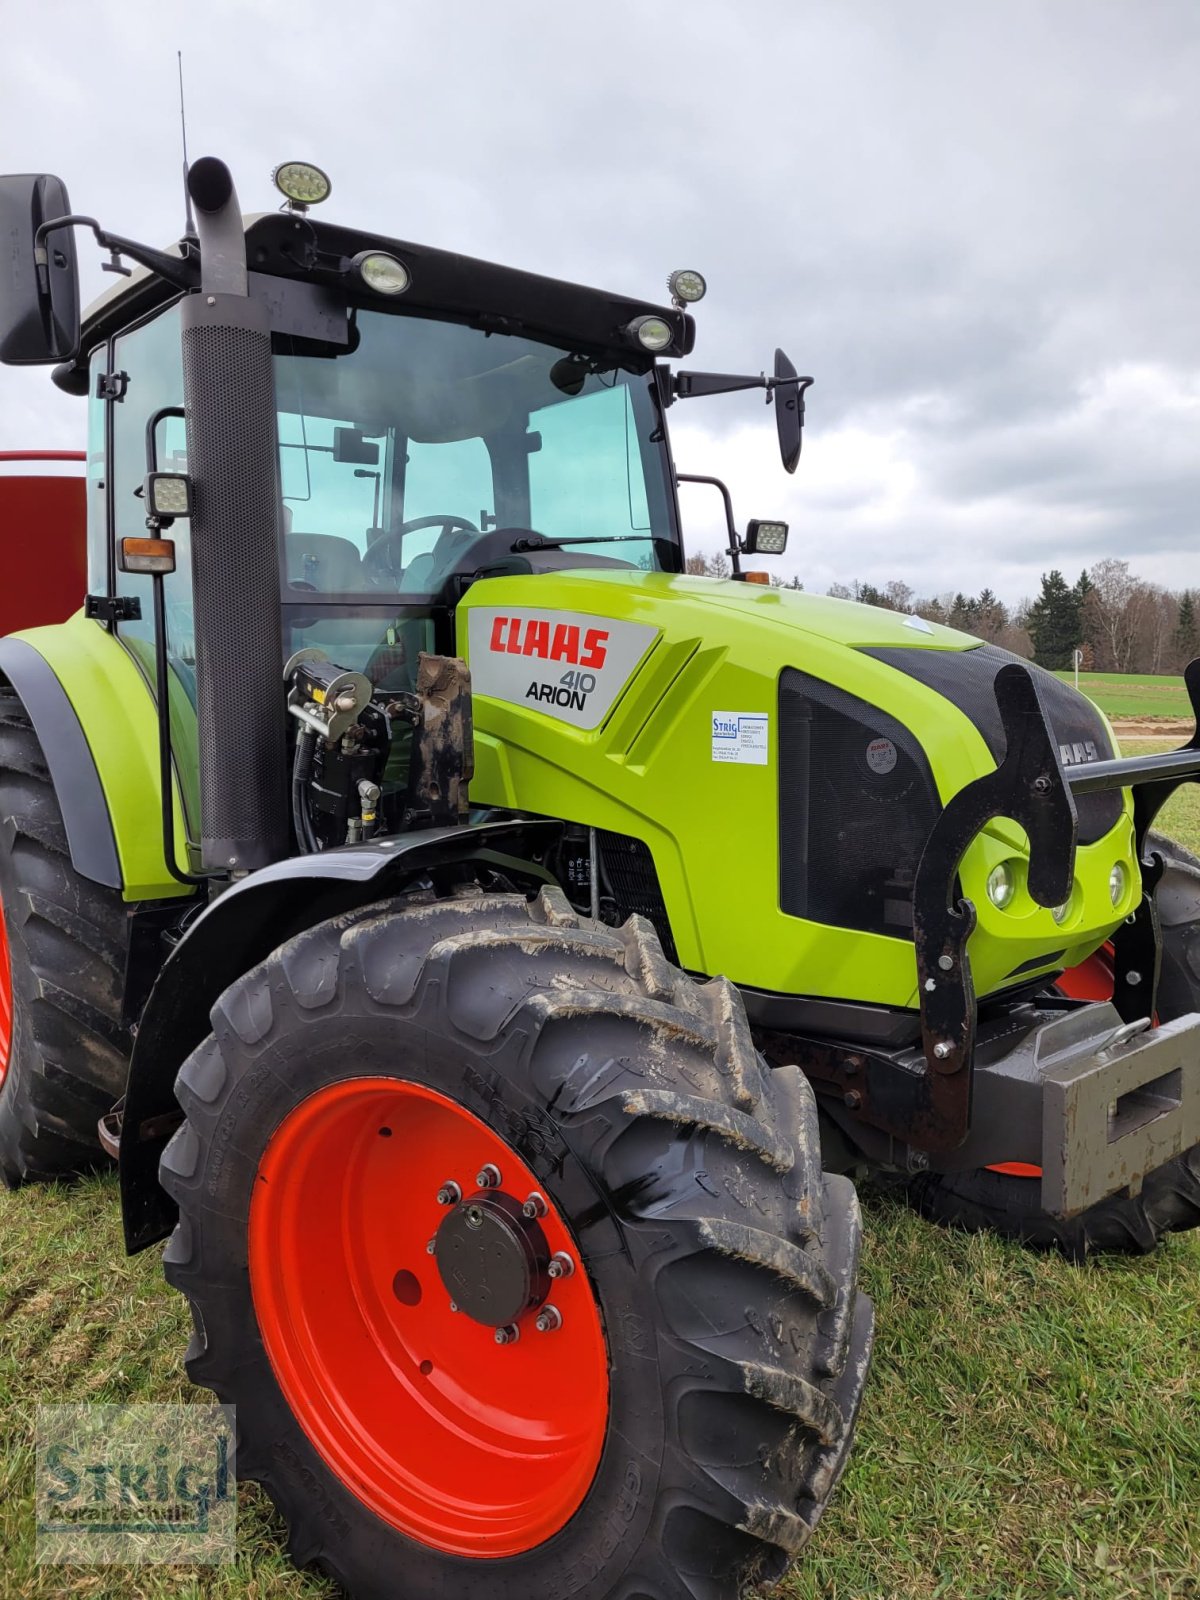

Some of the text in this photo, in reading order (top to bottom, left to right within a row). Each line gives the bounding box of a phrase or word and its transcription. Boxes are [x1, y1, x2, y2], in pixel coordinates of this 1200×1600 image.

[489, 616, 610, 670] CLAAS
[559, 670, 597, 694] 410
[525, 681, 587, 711] ARION
[1059, 741, 1098, 765] AAS
